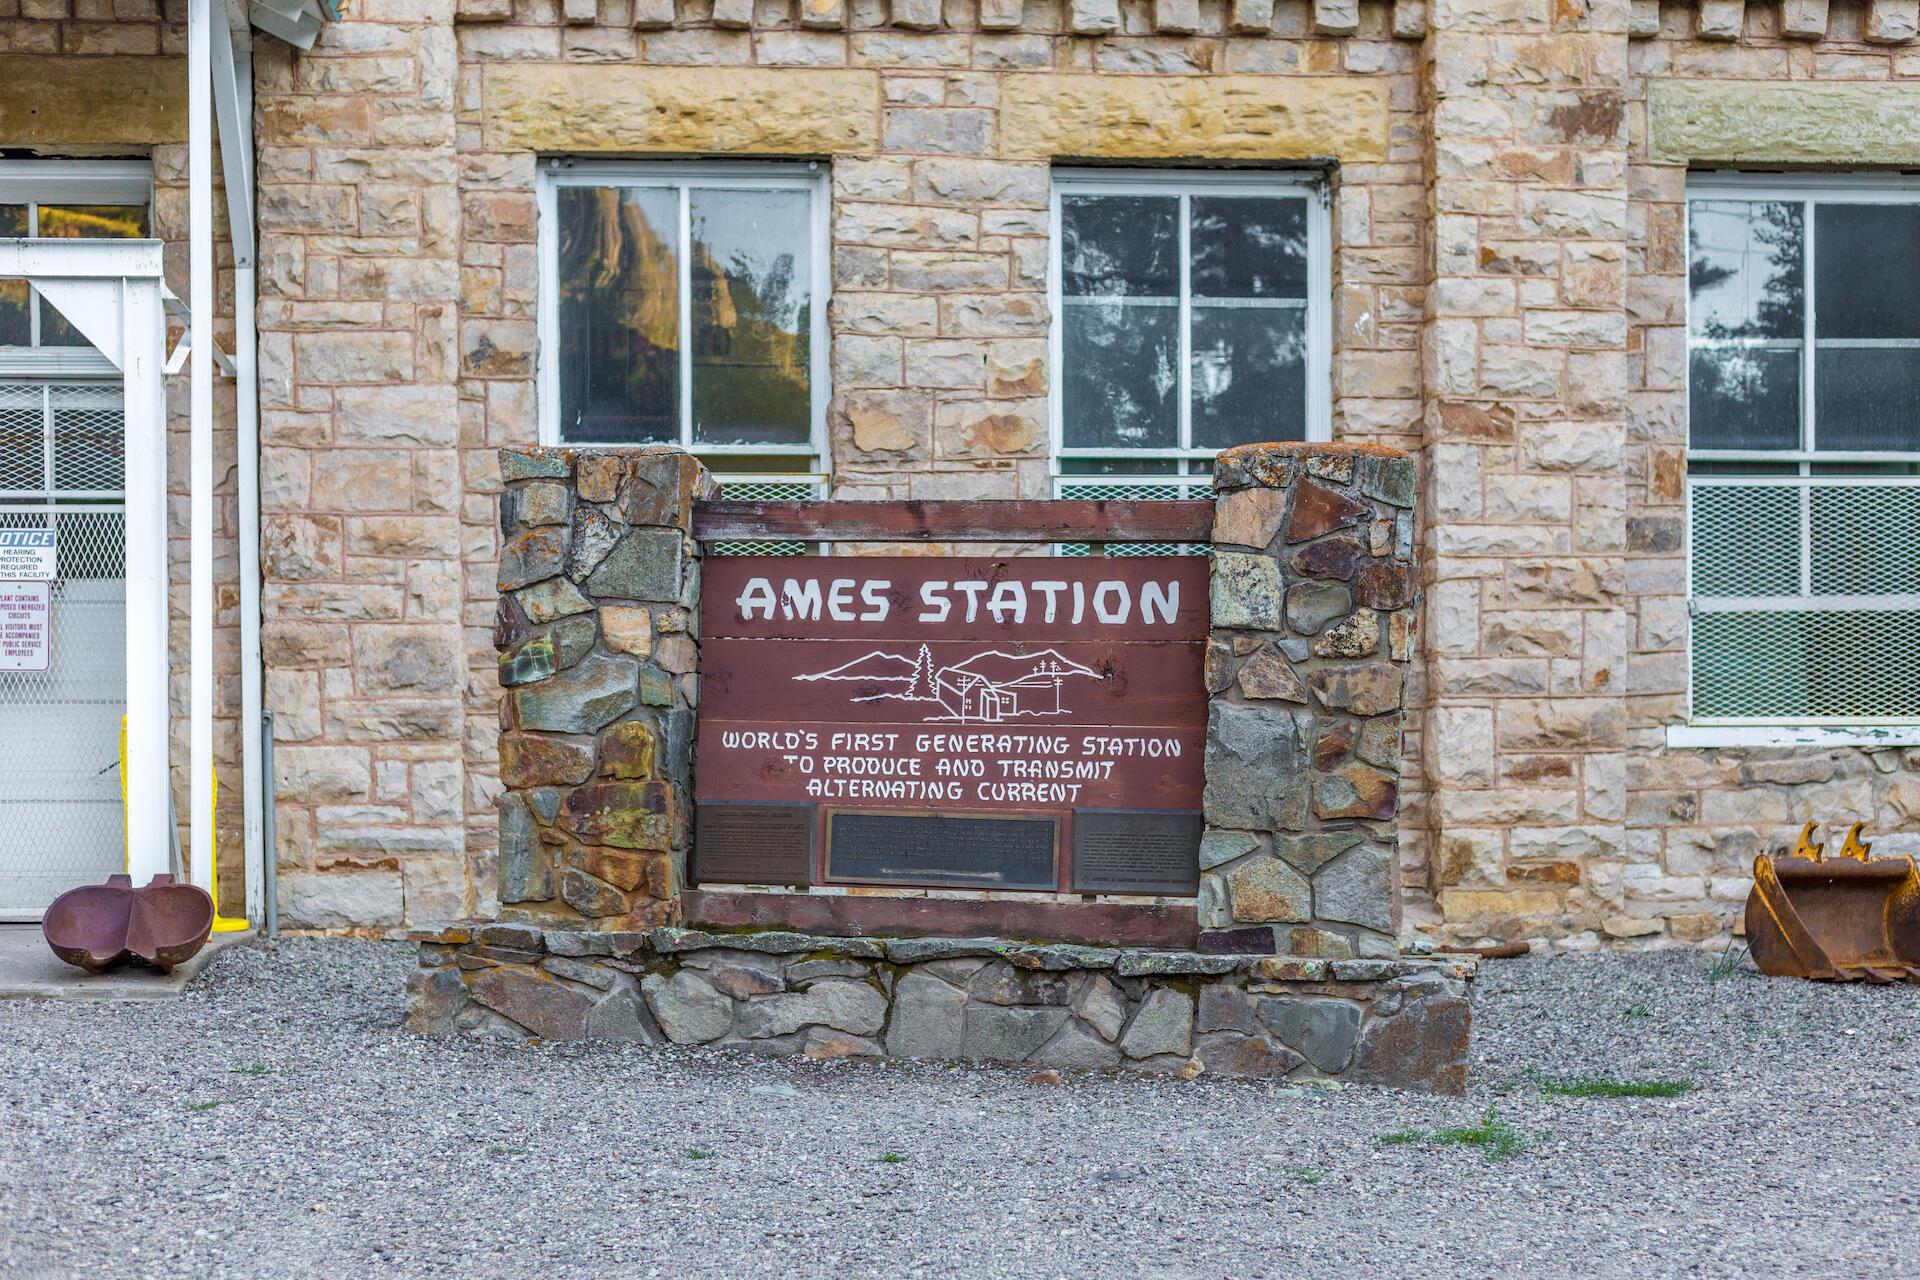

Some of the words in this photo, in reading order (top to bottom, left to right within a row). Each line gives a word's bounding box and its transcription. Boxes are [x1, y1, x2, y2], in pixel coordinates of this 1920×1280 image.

[0, 532, 53, 545] OTICE
[18, 603, 46, 611] ENERGIZED
[735, 577, 891, 622] AMES
[917, 579, 1180, 625] STATION
[721, 729, 818, 750] WORLD'S
[831, 733, 899, 751] FIRST
[915, 734, 1070, 755] GENERATING
[1081, 736, 1182, 758] STATION
[783, 755, 814, 774] TO
[823, 756, 921, 776] PRODUCE
[935, 758, 985, 777] AND
[997, 759, 1115, 780] TRANSMIT
[806, 778, 963, 800] ALTERNATING
[977, 782, 1082, 803] CURRENT
